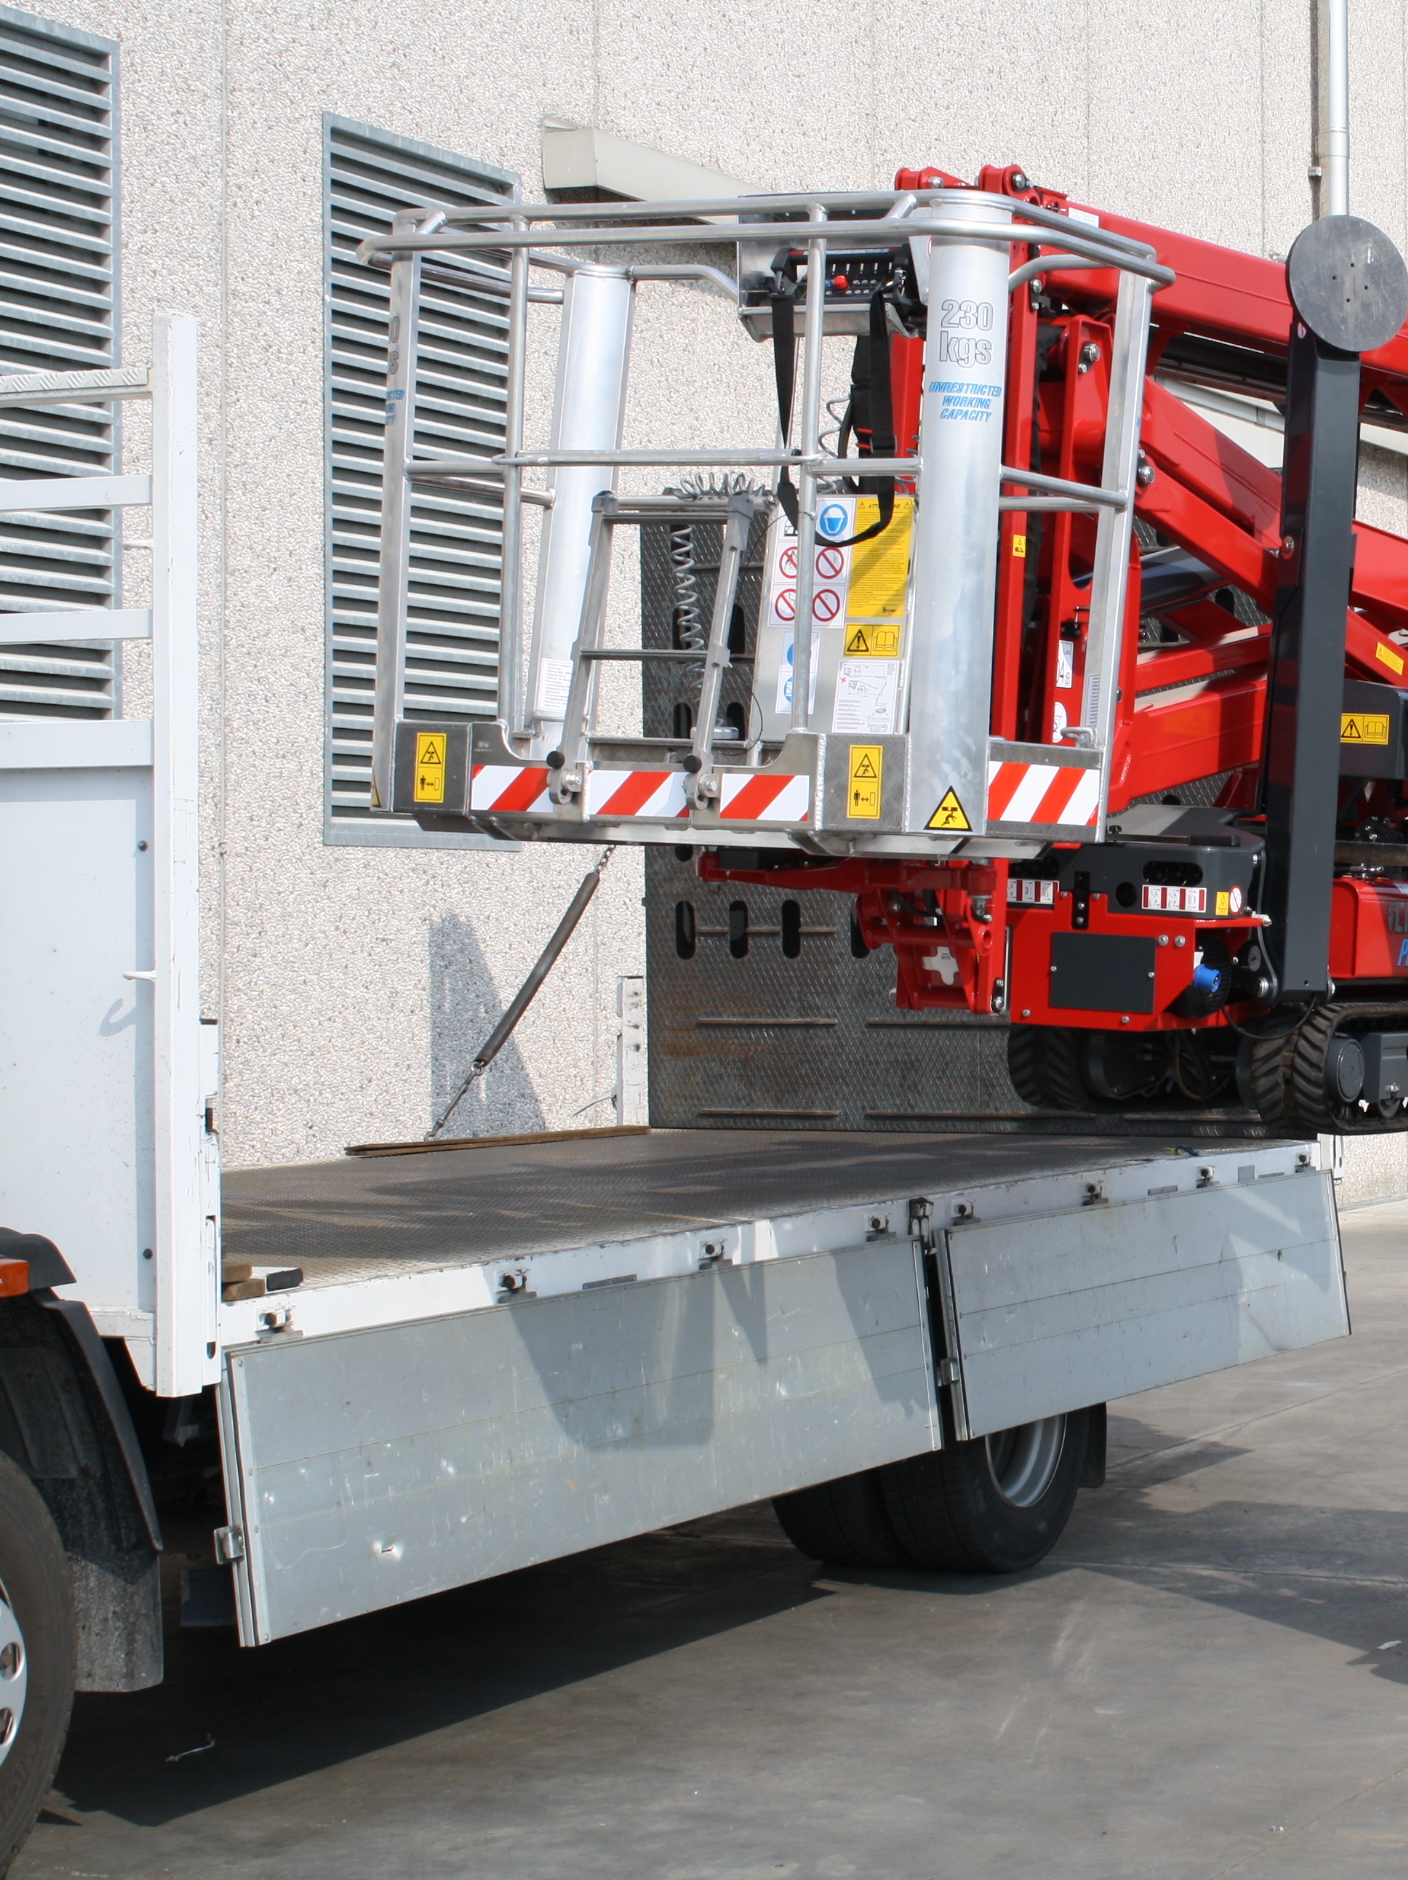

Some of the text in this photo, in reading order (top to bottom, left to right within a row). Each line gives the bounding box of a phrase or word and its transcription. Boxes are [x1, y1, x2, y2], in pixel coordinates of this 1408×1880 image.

[941, 299, 994, 331] 230
[939, 331, 992, 368] kgs
[928, 381, 1002, 397] UNRESTRICTED
[942, 396, 992, 409] WORKING
[940, 409, 992, 422] CAPACITY
